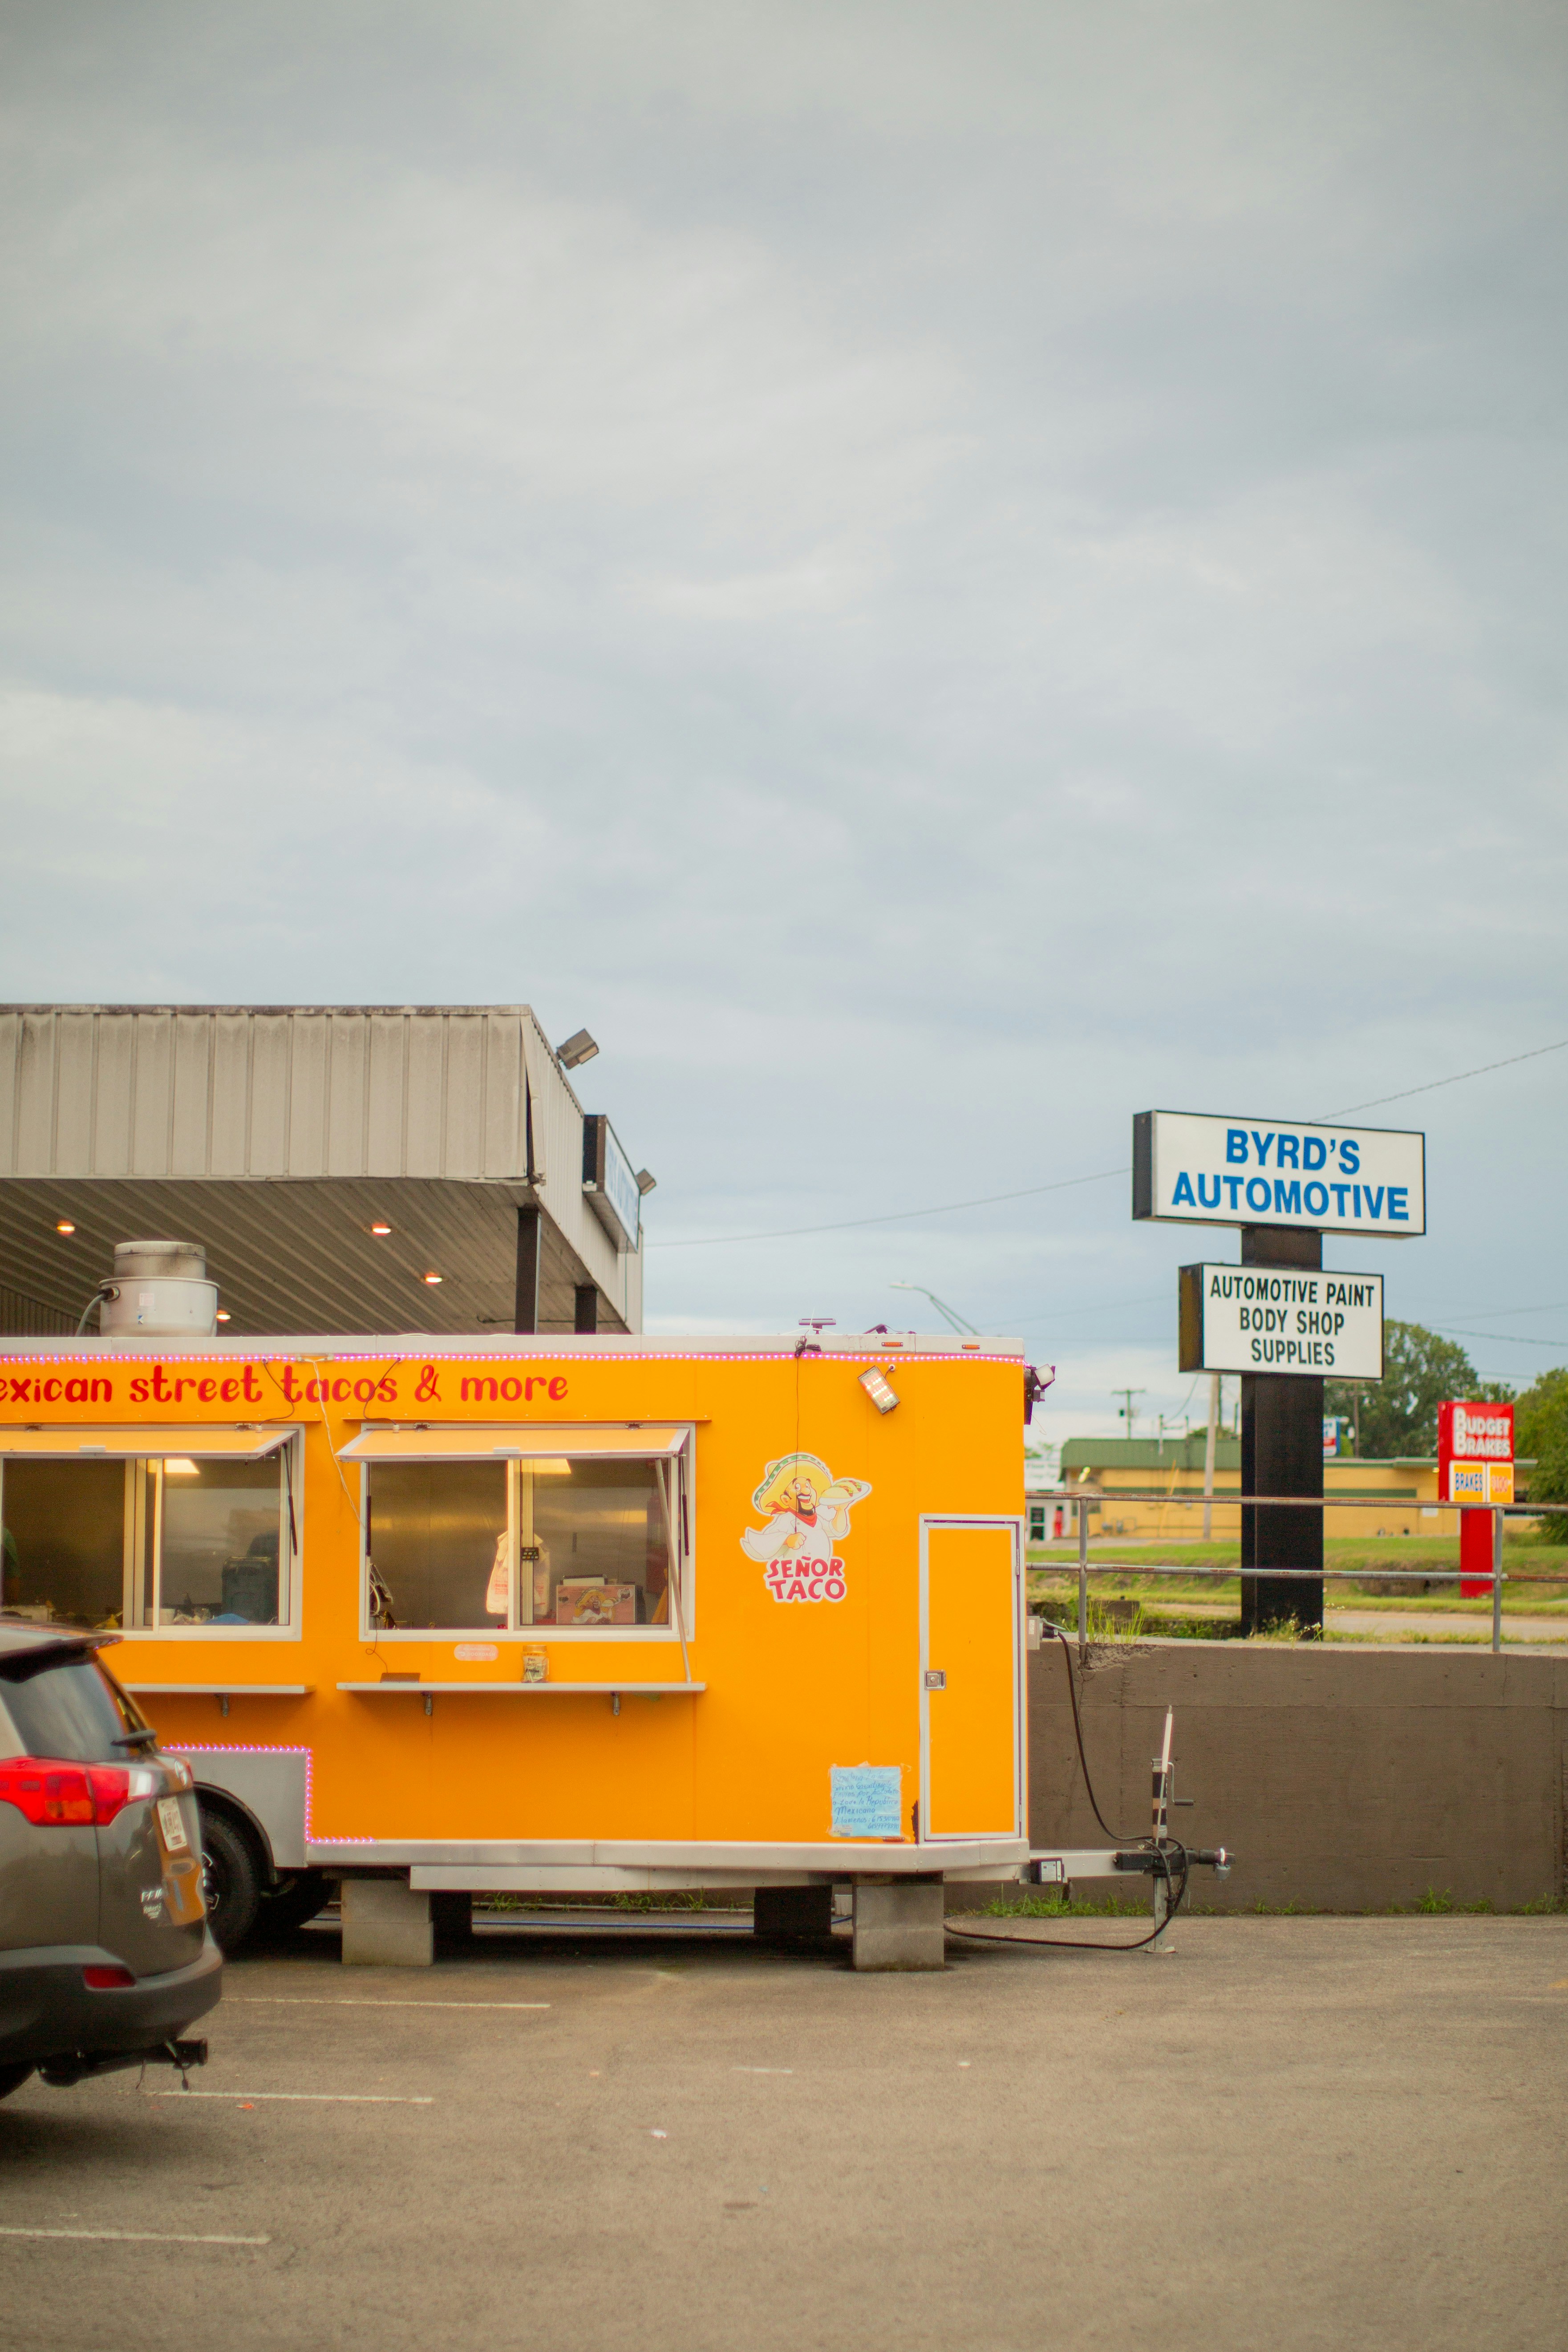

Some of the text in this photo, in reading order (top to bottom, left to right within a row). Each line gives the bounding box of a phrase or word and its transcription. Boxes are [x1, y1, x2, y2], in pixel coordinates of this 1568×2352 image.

[1226, 1129, 1360, 1175] BYRD'S
[1172, 1172, 1409, 1221] AUTOMOTIVE
[1211, 1276, 1374, 1307] AUTOMOTIVE PAINT
[1240, 1307, 1344, 1335] BODY SHOP
[1251, 1338, 1335, 1366] SUPPLIES
[129, 1365, 263, 1403] street
[280, 1365, 397, 1403] tacos
[414, 1364, 442, 1402] &
[461, 1376, 568, 1402] more
[1454, 1407, 1511, 1436] BUDGET
[1454, 1431, 1511, 1457] BRAKES
[1455, 1472, 1483, 1492] BRAKES
[767, 1556, 843, 1578] SEÑOR
[769, 1579, 845, 1600] TACO
